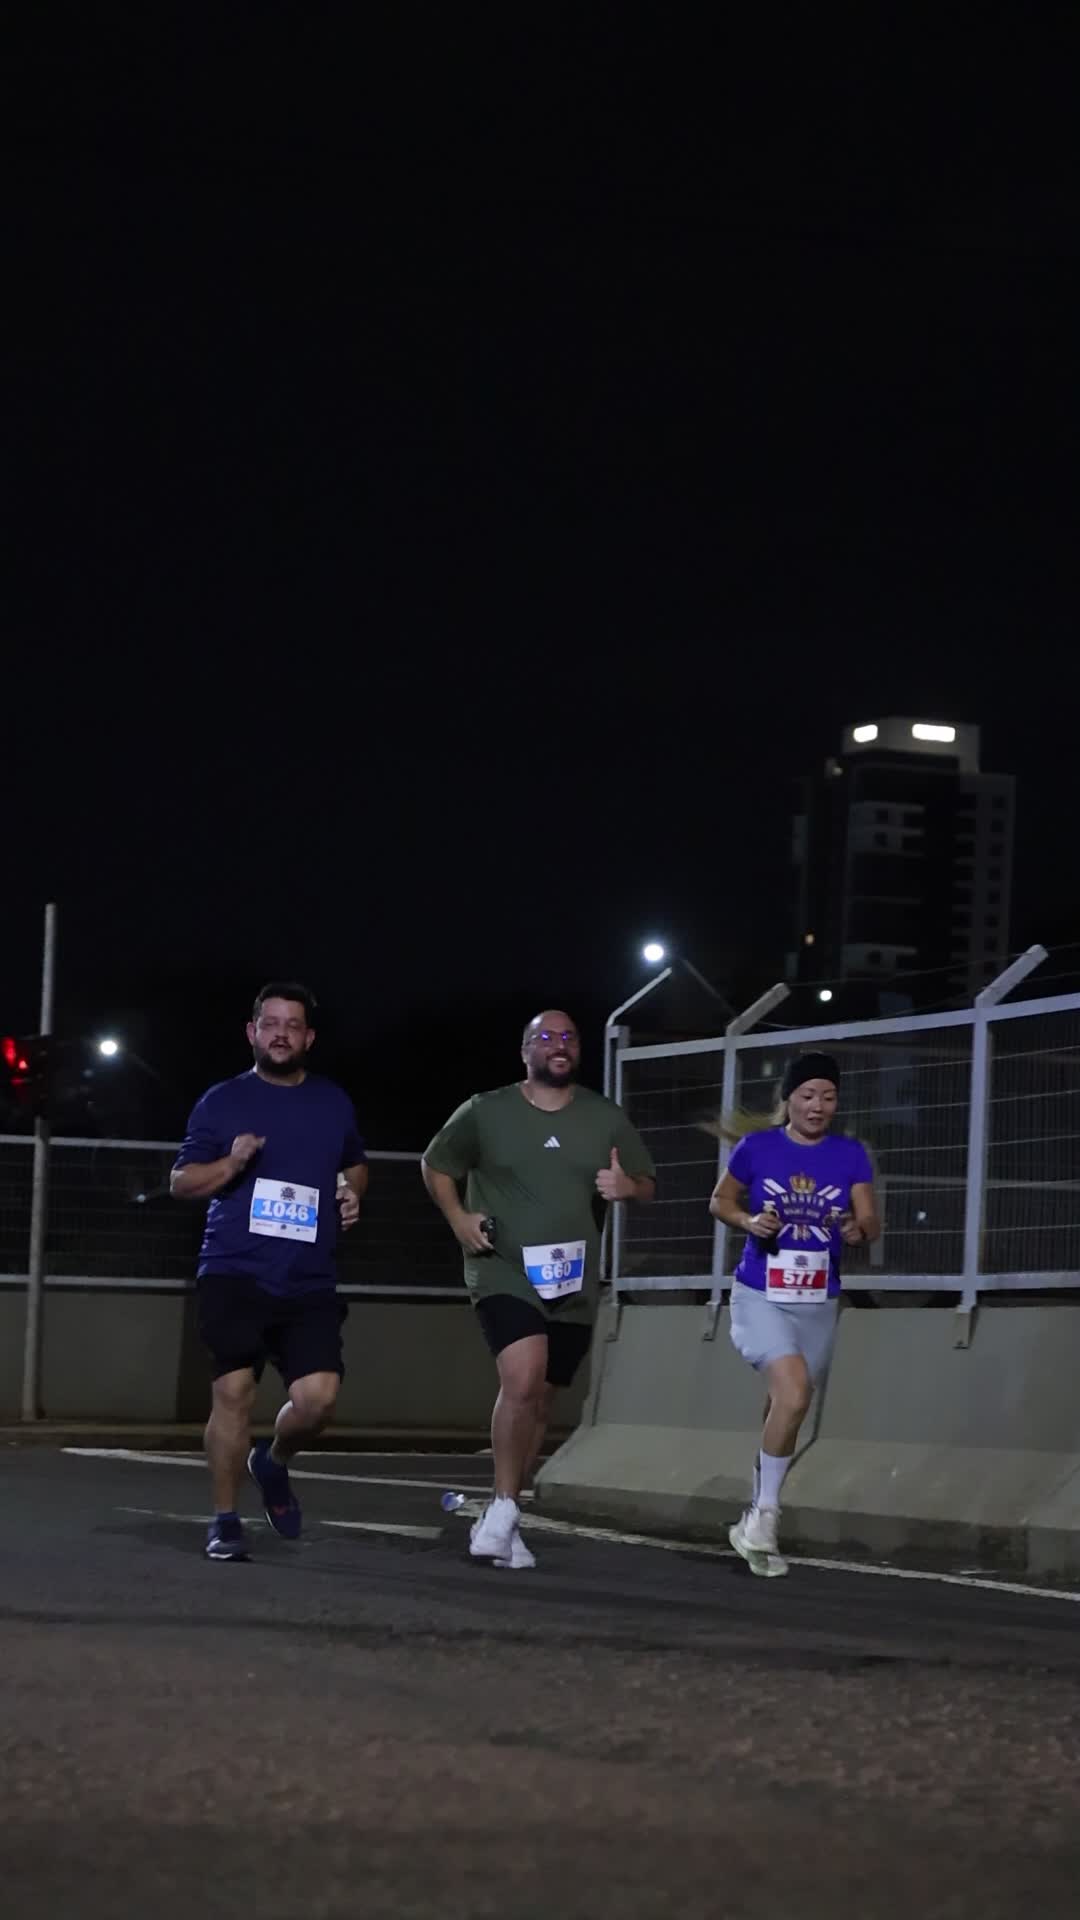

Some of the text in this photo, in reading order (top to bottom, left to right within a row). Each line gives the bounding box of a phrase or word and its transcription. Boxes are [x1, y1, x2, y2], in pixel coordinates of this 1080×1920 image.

[261, 1200, 309, 1221] 1046
[541, 1262, 571, 1280] 660
[782, 1270, 816, 1285] 577
